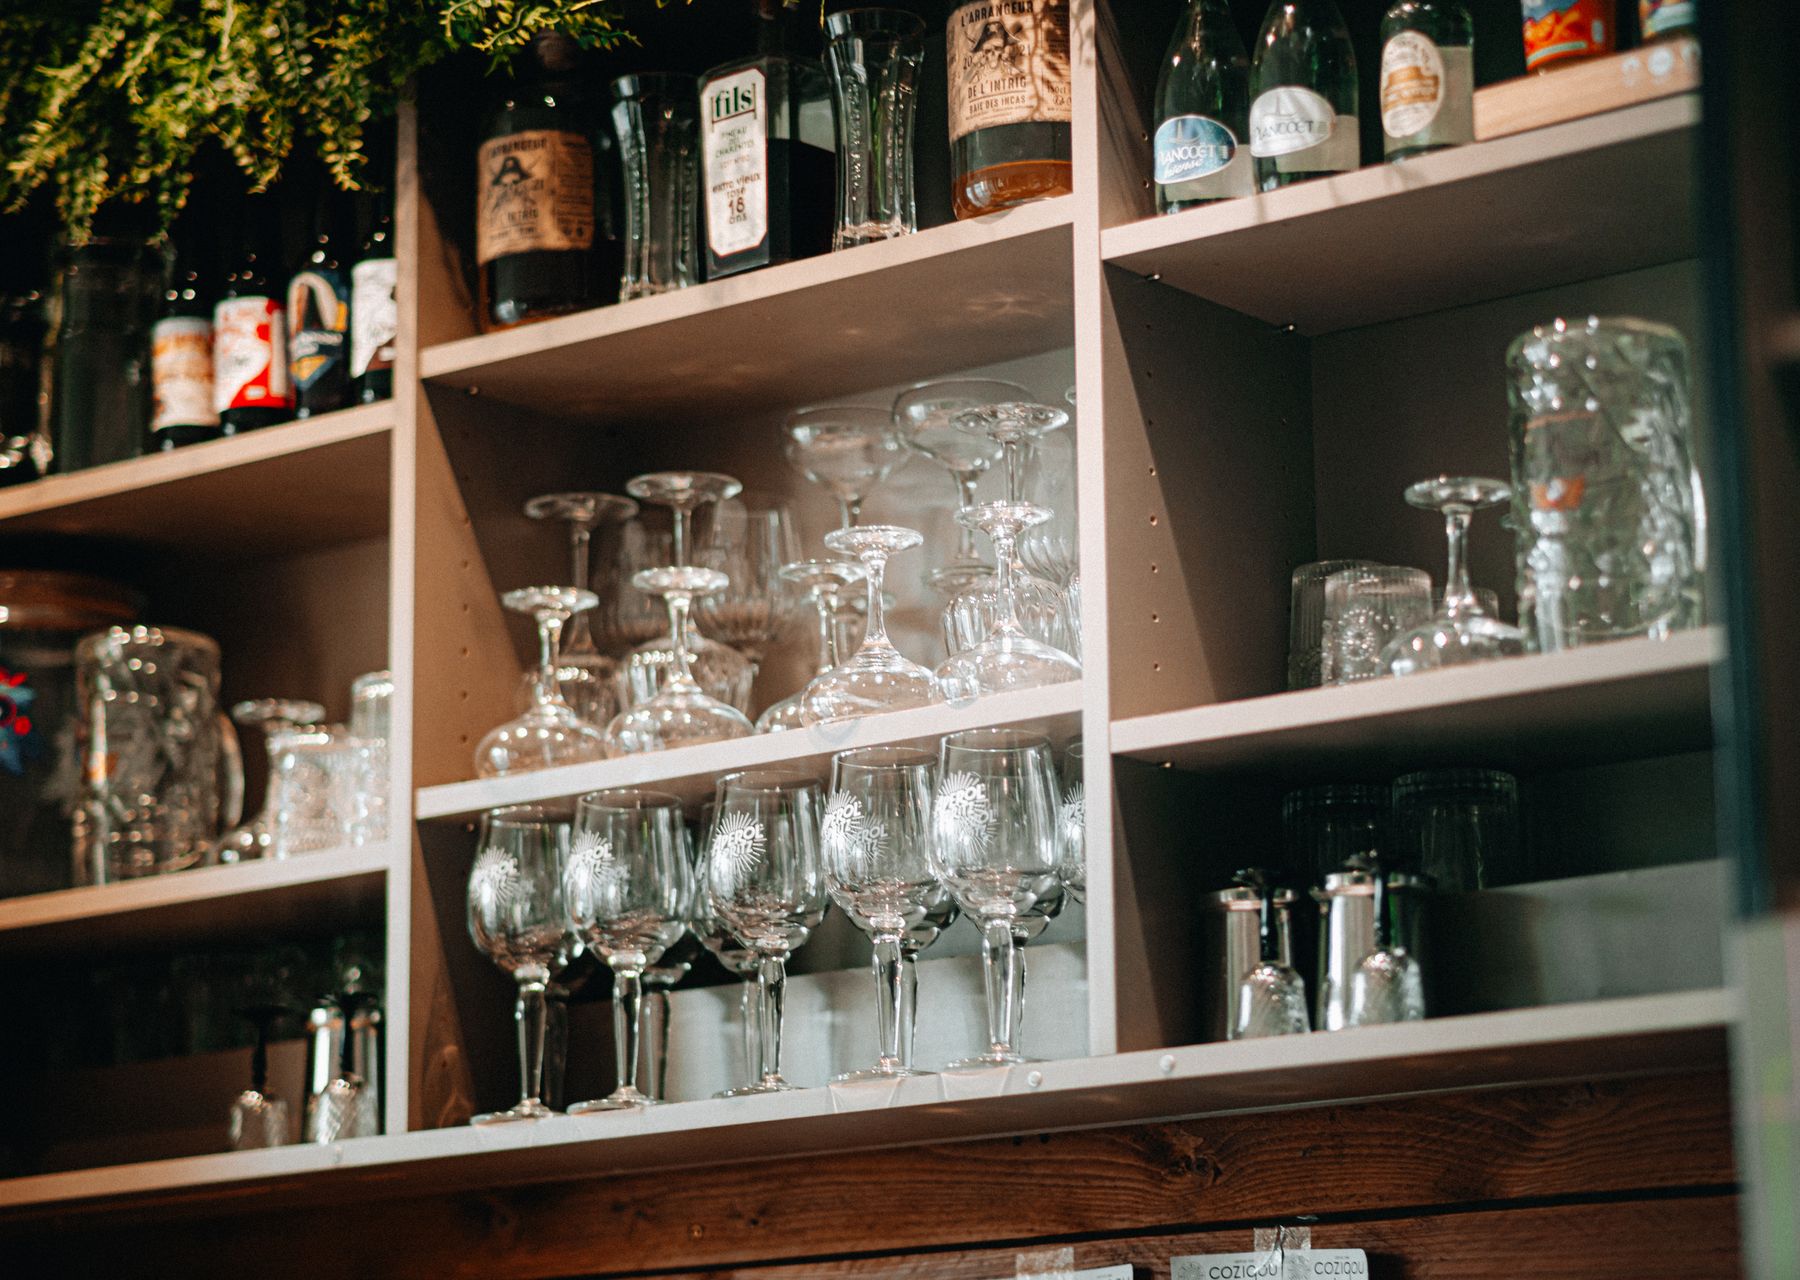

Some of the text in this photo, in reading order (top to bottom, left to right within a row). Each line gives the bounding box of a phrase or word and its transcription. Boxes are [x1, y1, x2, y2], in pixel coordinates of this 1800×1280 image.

[961, 0, 1034, 27] L'ARRANGEUR
[968, 84, 977, 98] DE
[715, 86, 752, 118] fils
[985, 99, 999, 109] DES
[1001, 95, 1026, 105] INCAS
[729, 197, 745, 216] 18
[729, 213, 747, 224] ans
